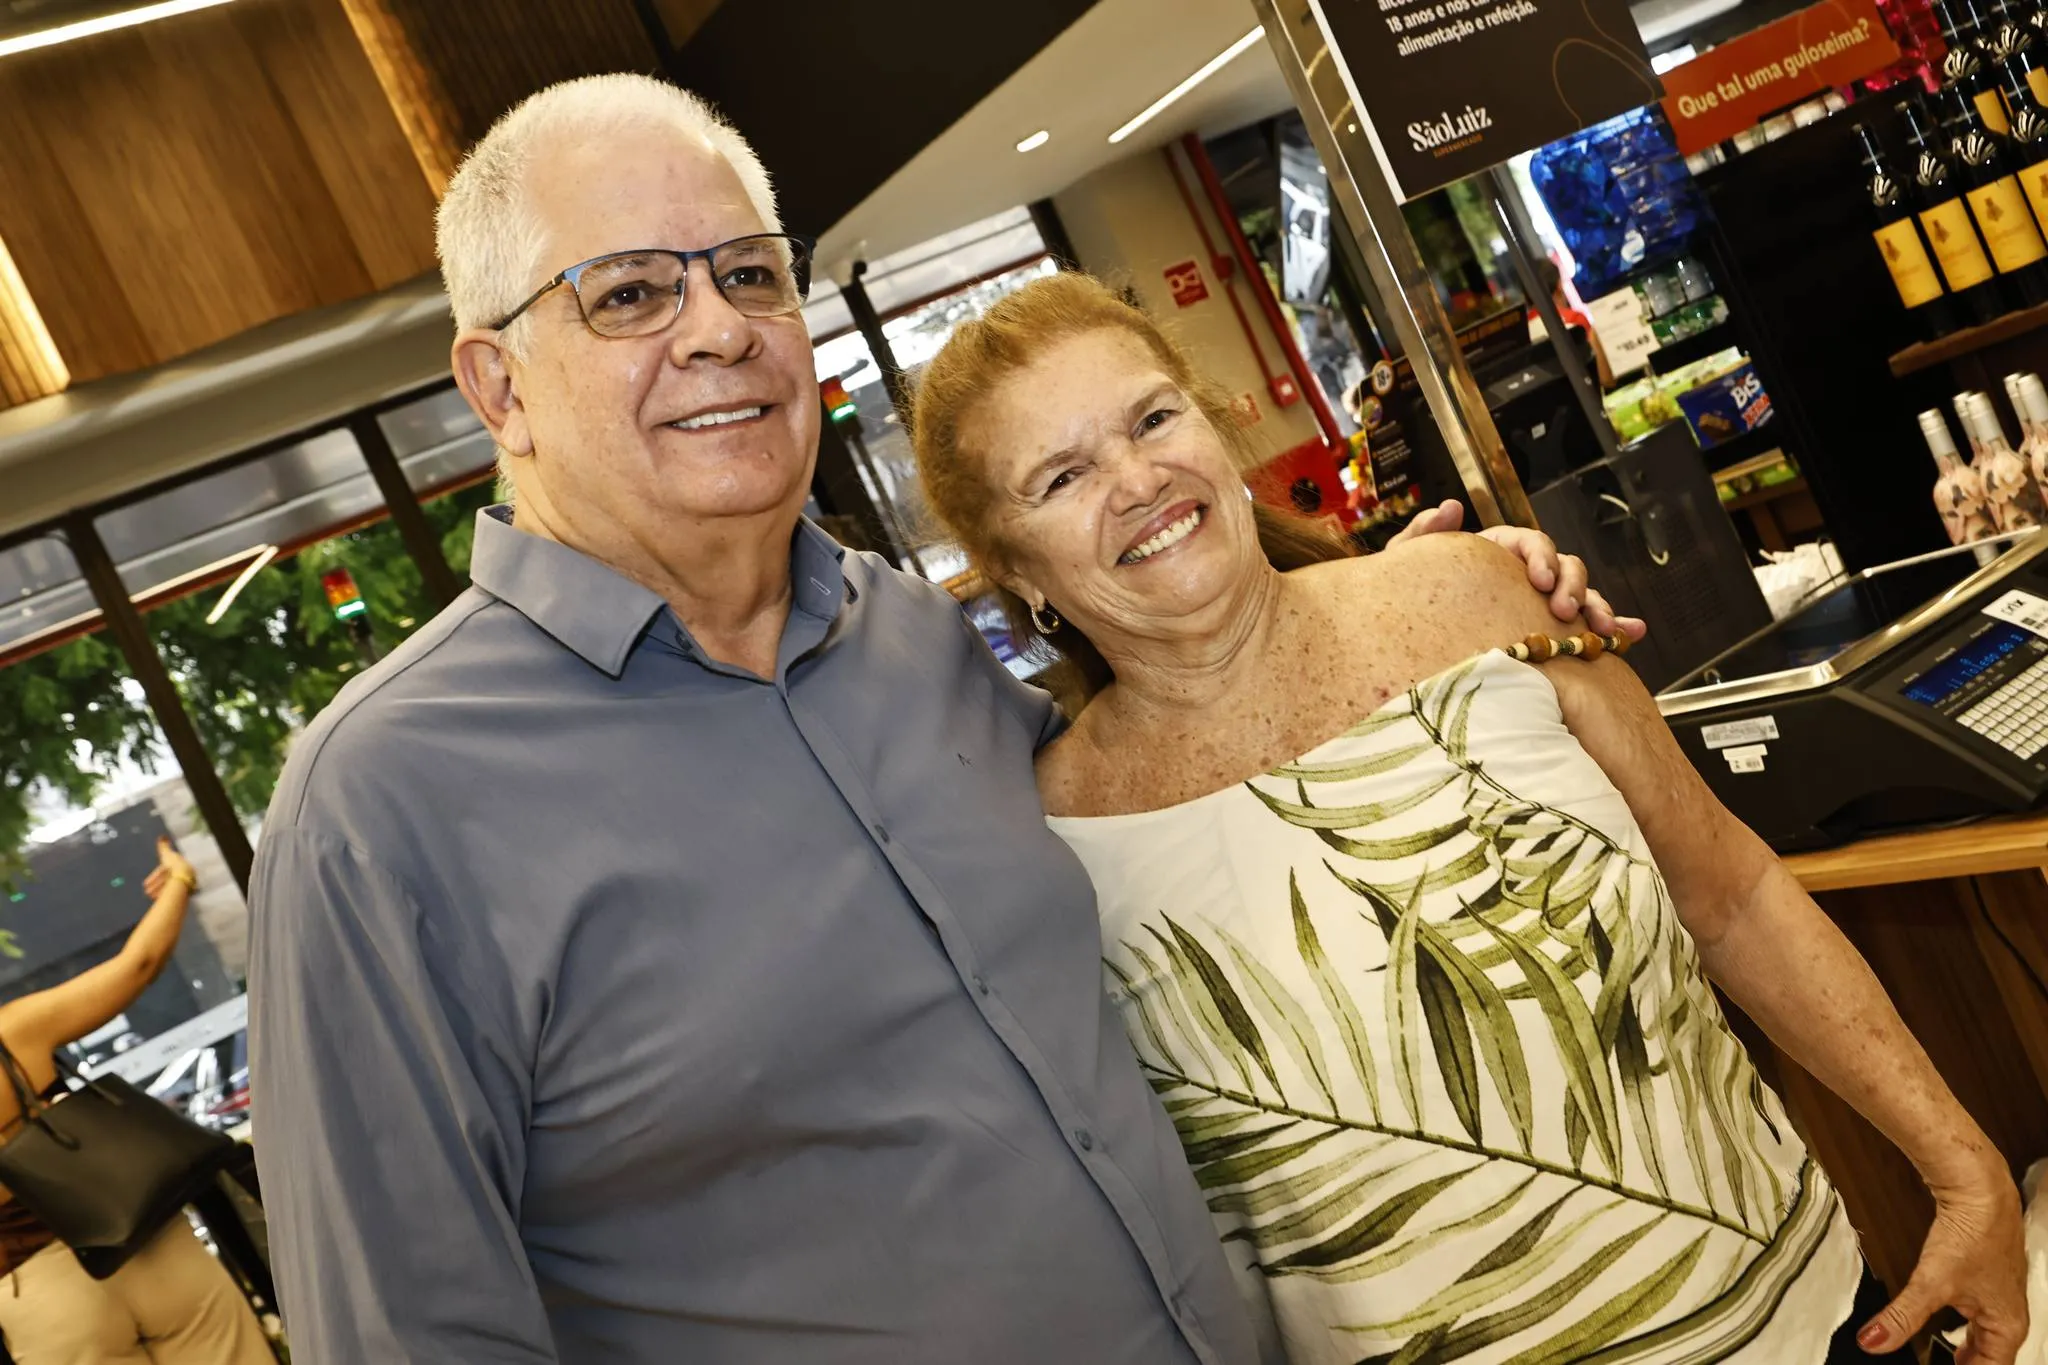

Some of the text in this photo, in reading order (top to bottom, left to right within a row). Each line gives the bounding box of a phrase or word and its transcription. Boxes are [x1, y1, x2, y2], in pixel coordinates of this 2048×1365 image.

[1385, 15, 1404, 34] 18
[1403, 7, 1436, 29] anos
[1435, 4, 1447, 19] e
[1444, 0, 1471, 15] nos
[1397, 0, 1538, 56] alimentação e refeição.
[1677, 17, 1870, 119] Que tal uma guloseima?
